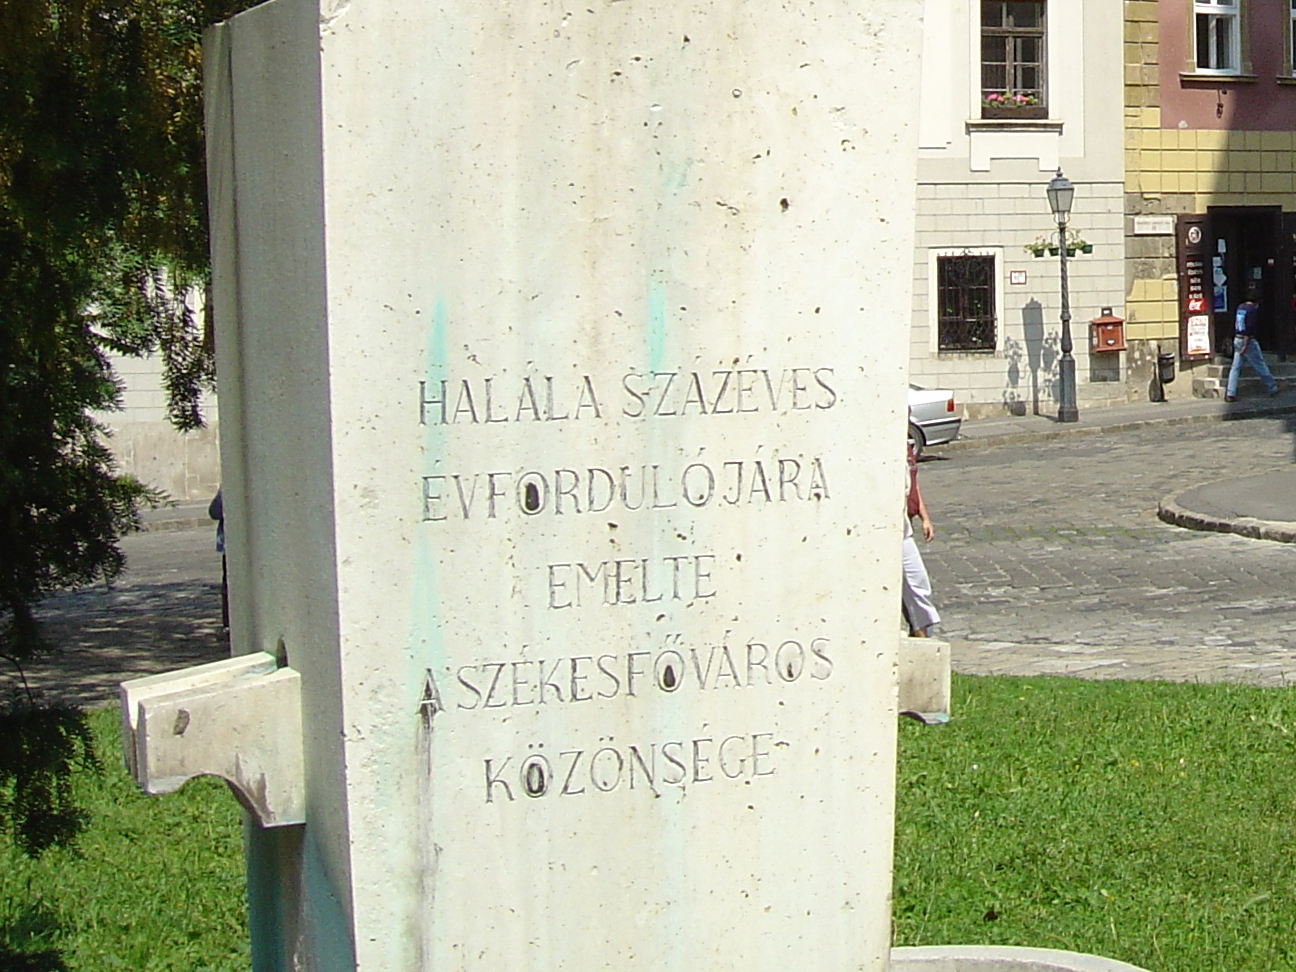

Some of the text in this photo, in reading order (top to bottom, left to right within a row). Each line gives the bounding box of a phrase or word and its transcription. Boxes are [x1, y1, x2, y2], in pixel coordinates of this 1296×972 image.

[417, 355, 838, 427] HALÁLA SZÁZÉVES
[421, 446, 832, 523] ÉVFORDULÓJÁRA
[546, 553, 718, 611] EMELTE
[416, 630, 835, 714] A SZÉKESFŐVÁROS
[483, 723, 779, 804] KÖZÖNSÉGE
